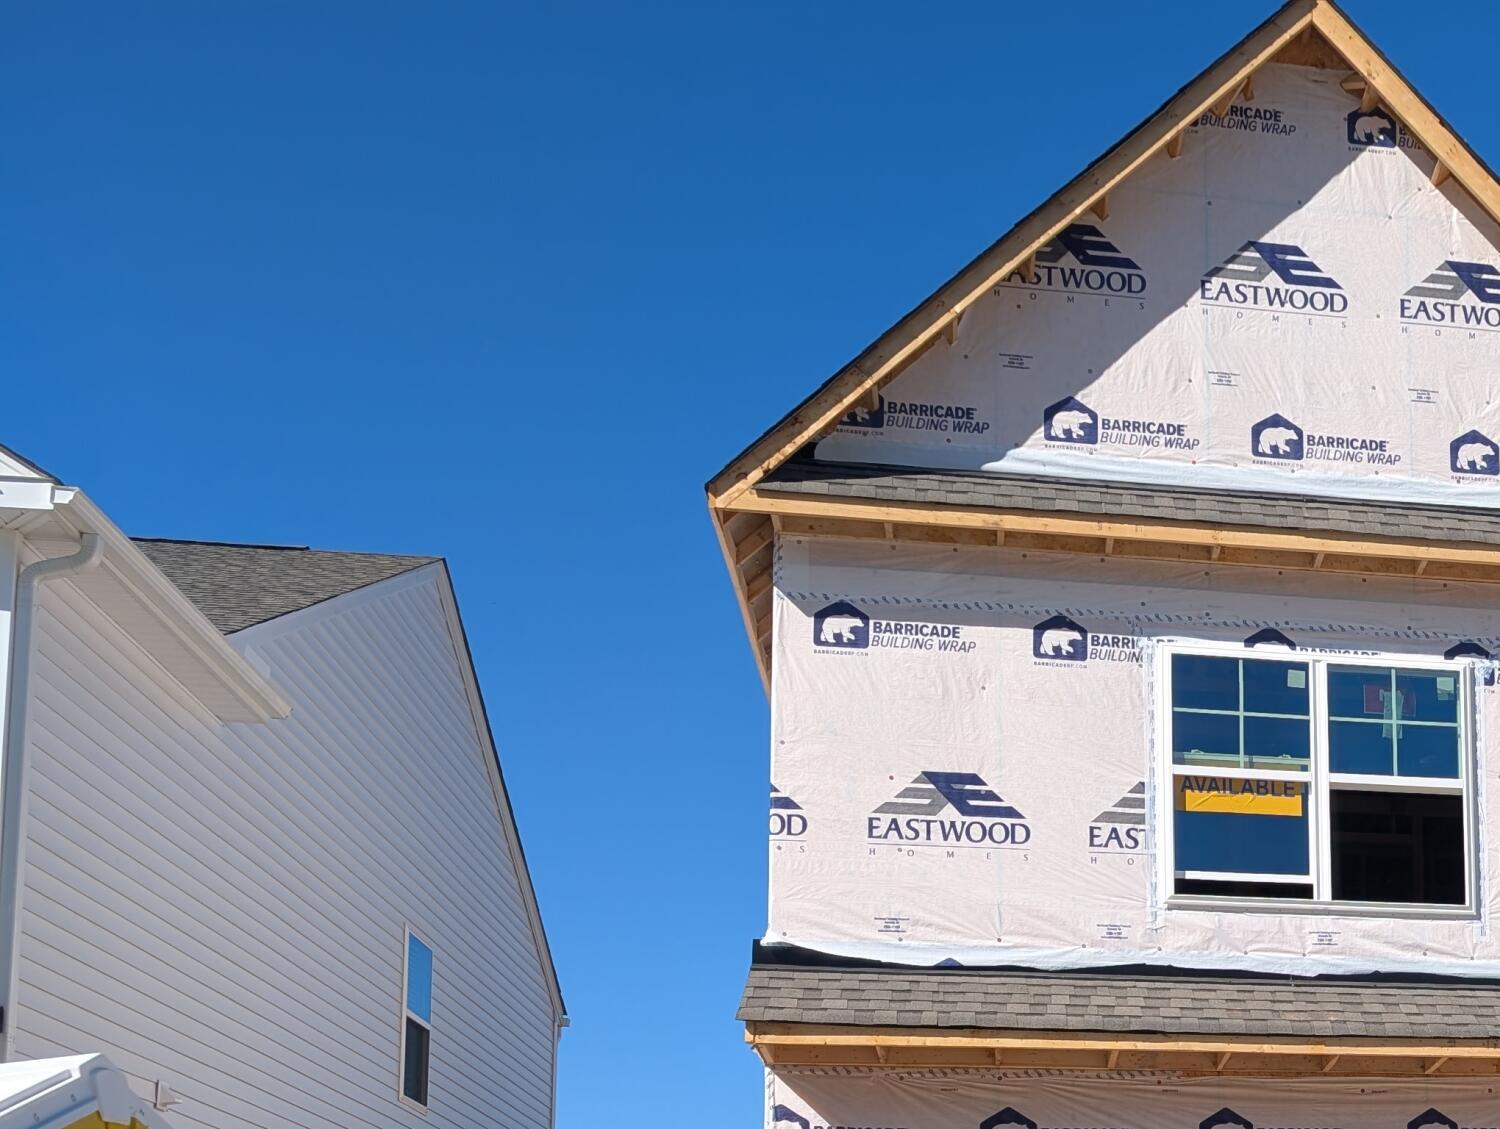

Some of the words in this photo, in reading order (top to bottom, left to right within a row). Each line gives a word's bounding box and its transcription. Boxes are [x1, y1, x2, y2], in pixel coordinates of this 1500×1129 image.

[1228, 105, 1282, 122] RICADE
[1200, 114, 1257, 132] BUILDING
[1261, 122, 1296, 136] WRAP
[1000, 263, 1146, 294] ASTWOOD
[1201, 280, 1348, 313] EASTWOOD
[1202, 308, 1346, 328] HOMES
[888, 401, 975, 420] BARRICADE
[886, 415, 948, 432] BUILDING
[951, 421, 990, 435] WRAP
[1102, 418, 1186, 436] BARRICADE
[1100, 431, 1160, 448] BUILDING
[1164, 436, 1200, 450] WRAP
[1306, 434, 1388, 452] BARRICADE
[1306, 448, 1366, 464] BUILDING
[1369, 453, 1401, 466] WRAP
[872, 622, 961, 639] BARRICADE
[871, 635, 934, 650] BUILDING
[938, 639, 976, 654] WRAP
[1090, 648, 1142, 664] BUILDIN
[1180, 776, 1296, 798] AVAILABLE
[867, 816, 1031, 845] EASTWOOD
[868, 848, 1030, 862] HOMES
